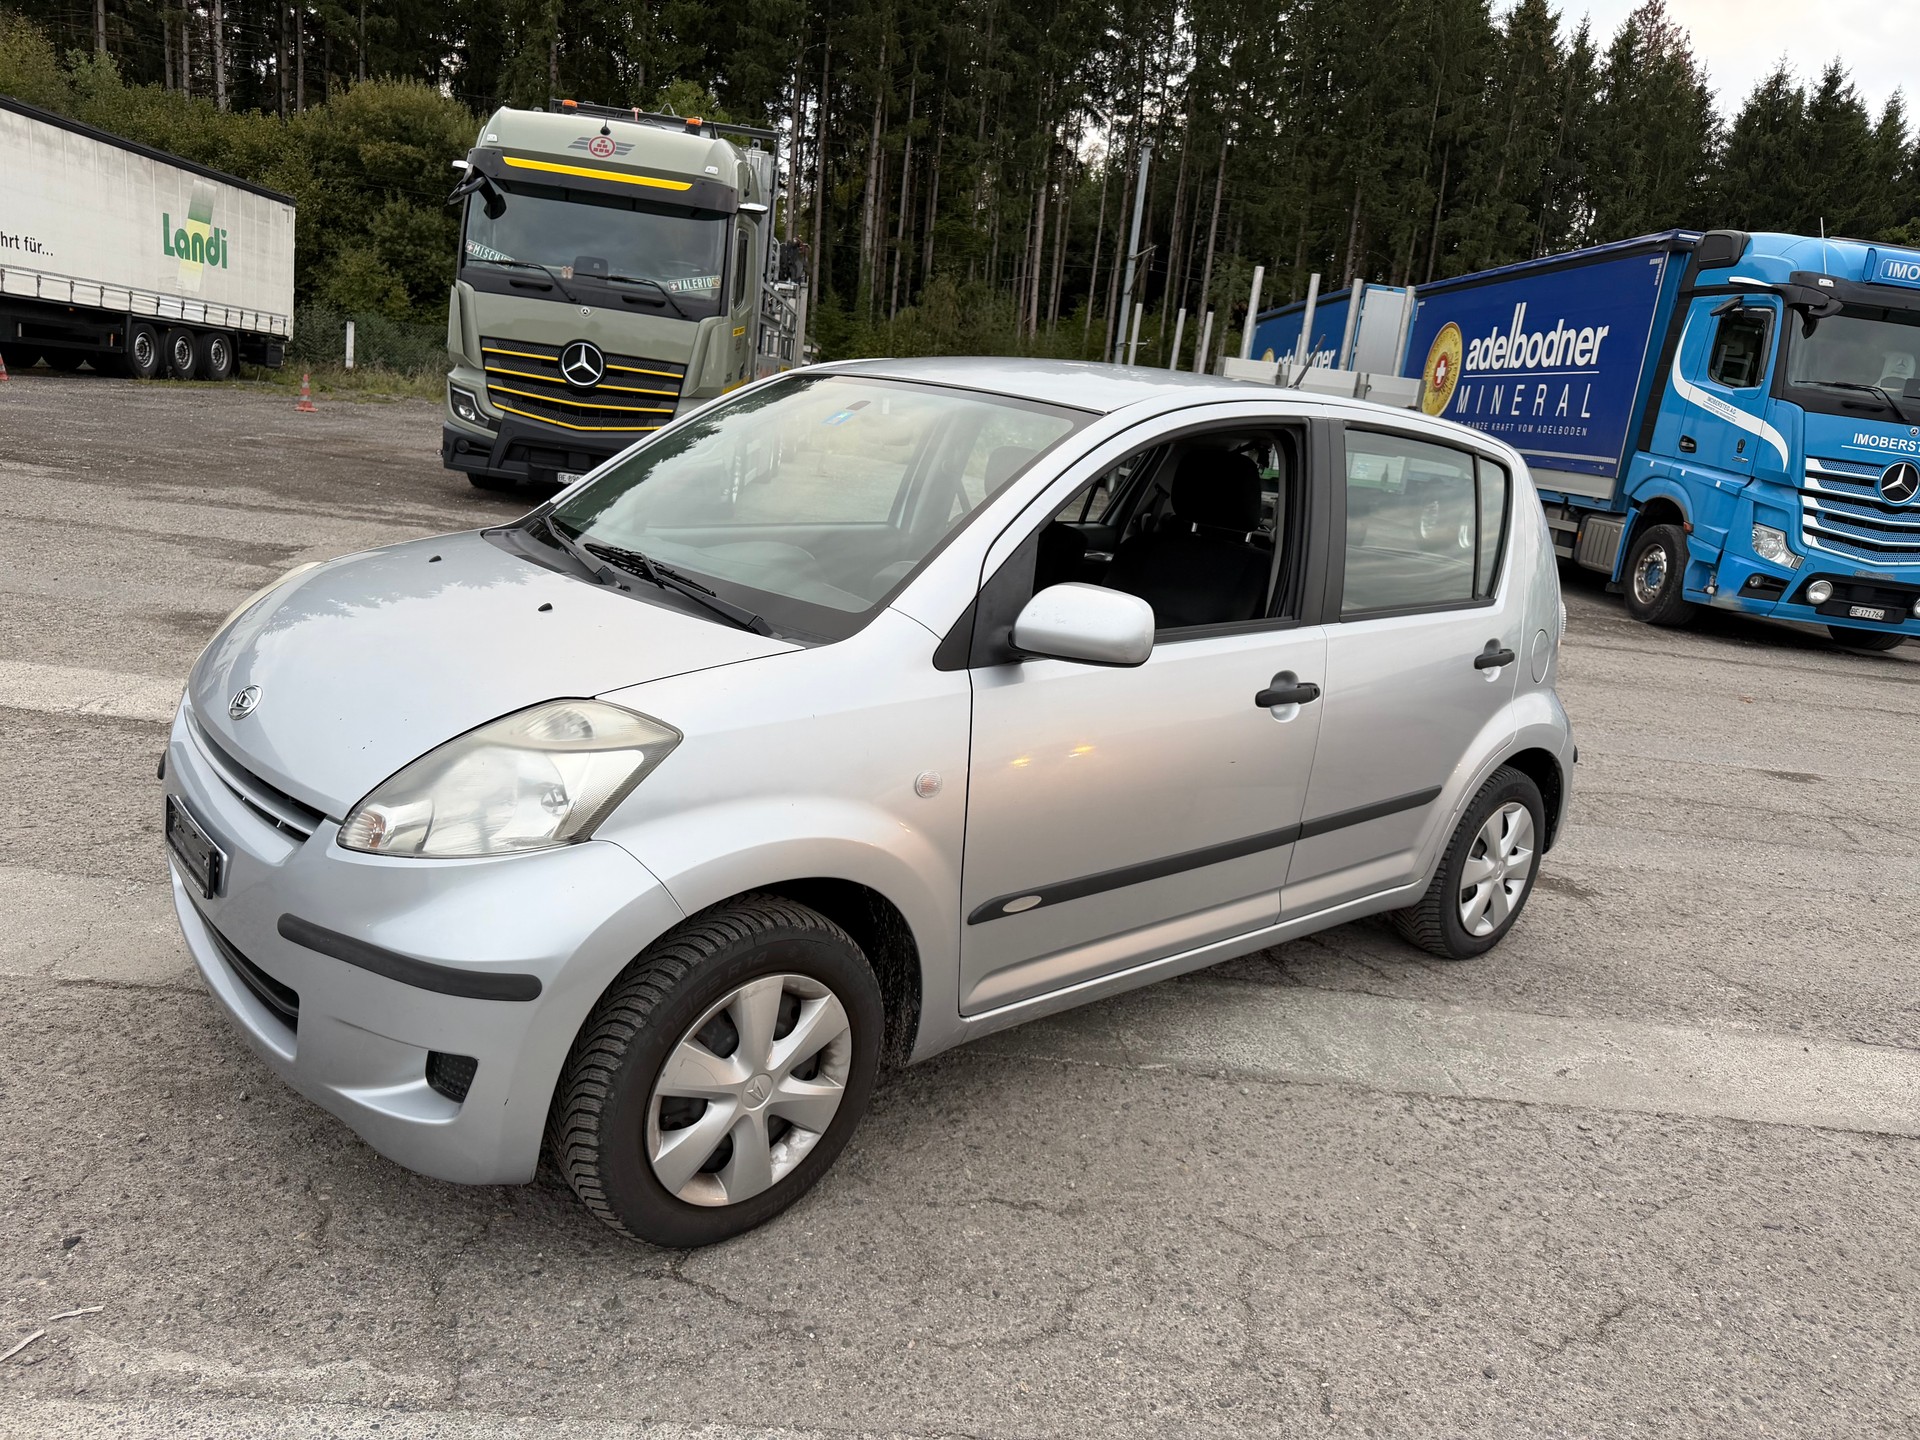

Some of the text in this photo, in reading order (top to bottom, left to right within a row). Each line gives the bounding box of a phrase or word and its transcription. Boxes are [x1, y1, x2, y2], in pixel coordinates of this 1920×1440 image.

[23, 236, 54, 257] für...
[162, 212, 228, 269] Landi
[1887, 262, 1920, 280] IMO
[677, 278, 713, 290] VALERIO
[1465, 302, 1610, 371] adelbodner
[1455, 383, 1592, 418] MINERAL
[1491, 422, 1515, 432] KRAFT
[1517, 423, 1534, 433] VOM
[1536, 424, 1588, 437] ADELBODEN
